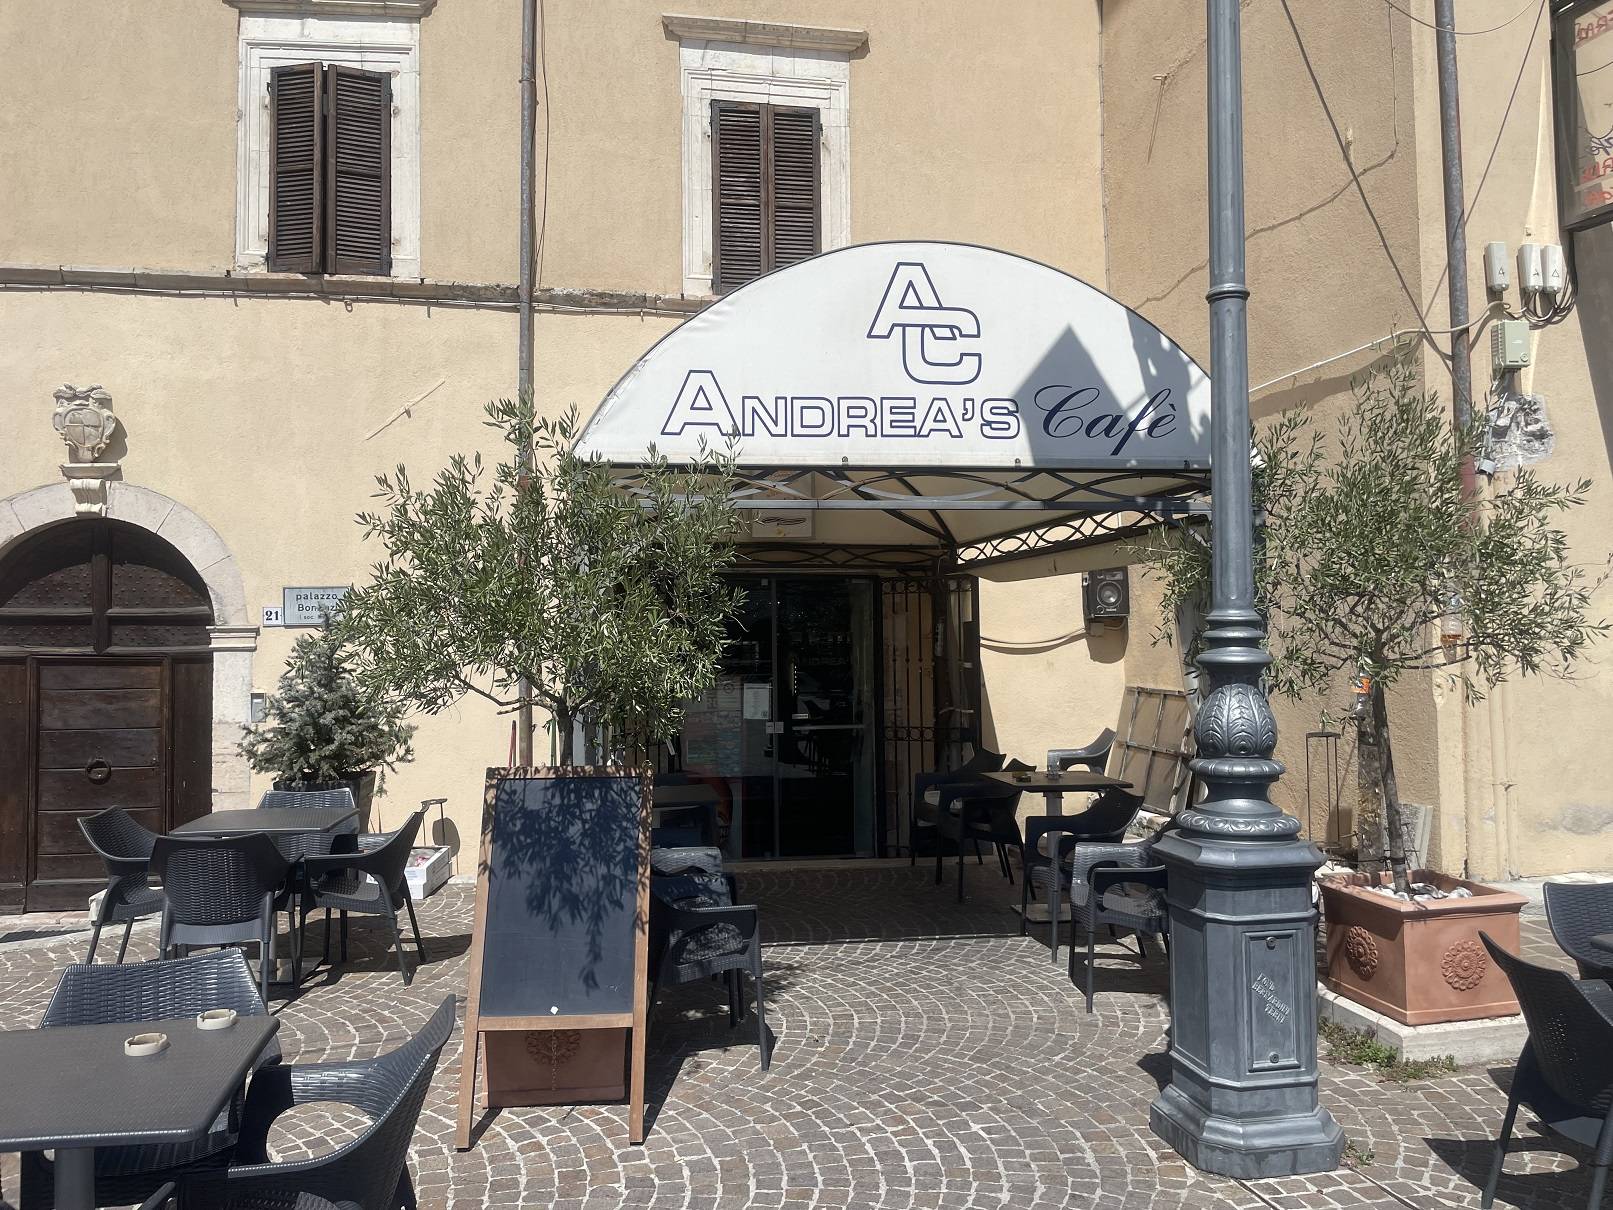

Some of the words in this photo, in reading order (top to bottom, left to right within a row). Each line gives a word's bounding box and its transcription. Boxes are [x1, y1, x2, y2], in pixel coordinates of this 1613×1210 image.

[661, 369, 1020, 440] ANDREA'S
[1034, 385, 1177, 456] Cafè
[295, 592, 338, 602] palazzo
[265, 610, 279, 621] 21
